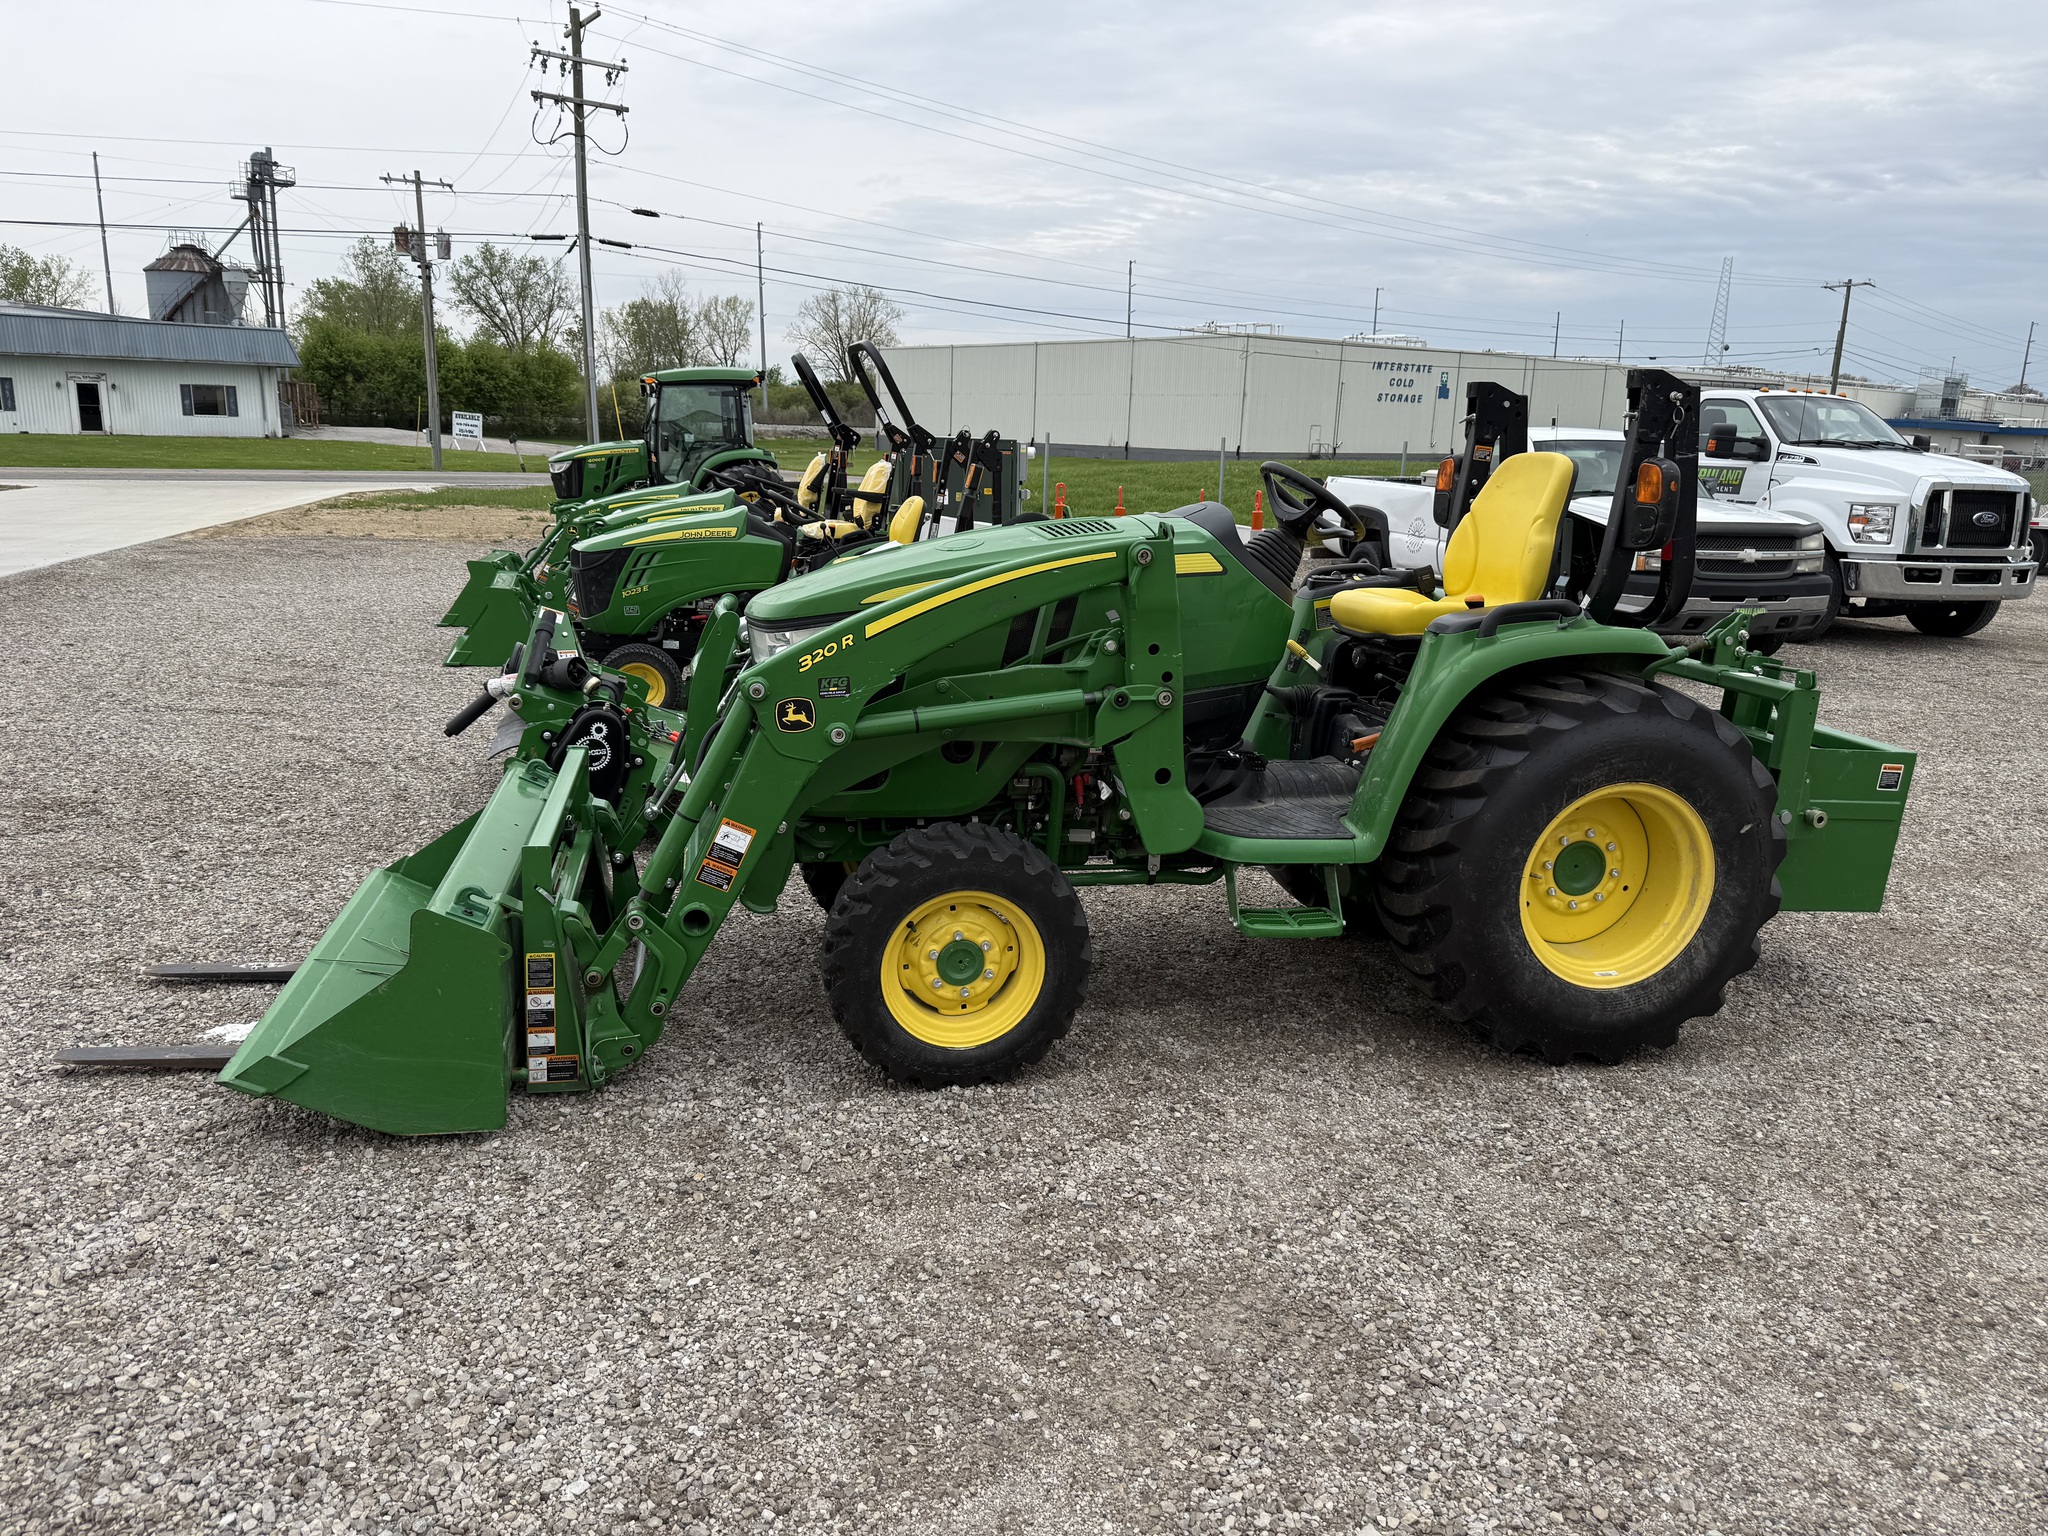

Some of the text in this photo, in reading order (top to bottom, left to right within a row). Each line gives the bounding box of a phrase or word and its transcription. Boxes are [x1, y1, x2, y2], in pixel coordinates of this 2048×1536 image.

[1372, 361, 1433, 373] INTERSTATE
[1389, 378, 1414, 387] COLD
[1377, 393, 1423, 403] STORAGE
[680, 530, 732, 539] JOHN DEERE
[622, 587, 641, 598] 1023
[799, 634, 854, 672] 320 R
[821, 677, 848, 688] KFG
[731, 823, 752, 833] WARNING
[712, 864, 733, 874] WARNING
